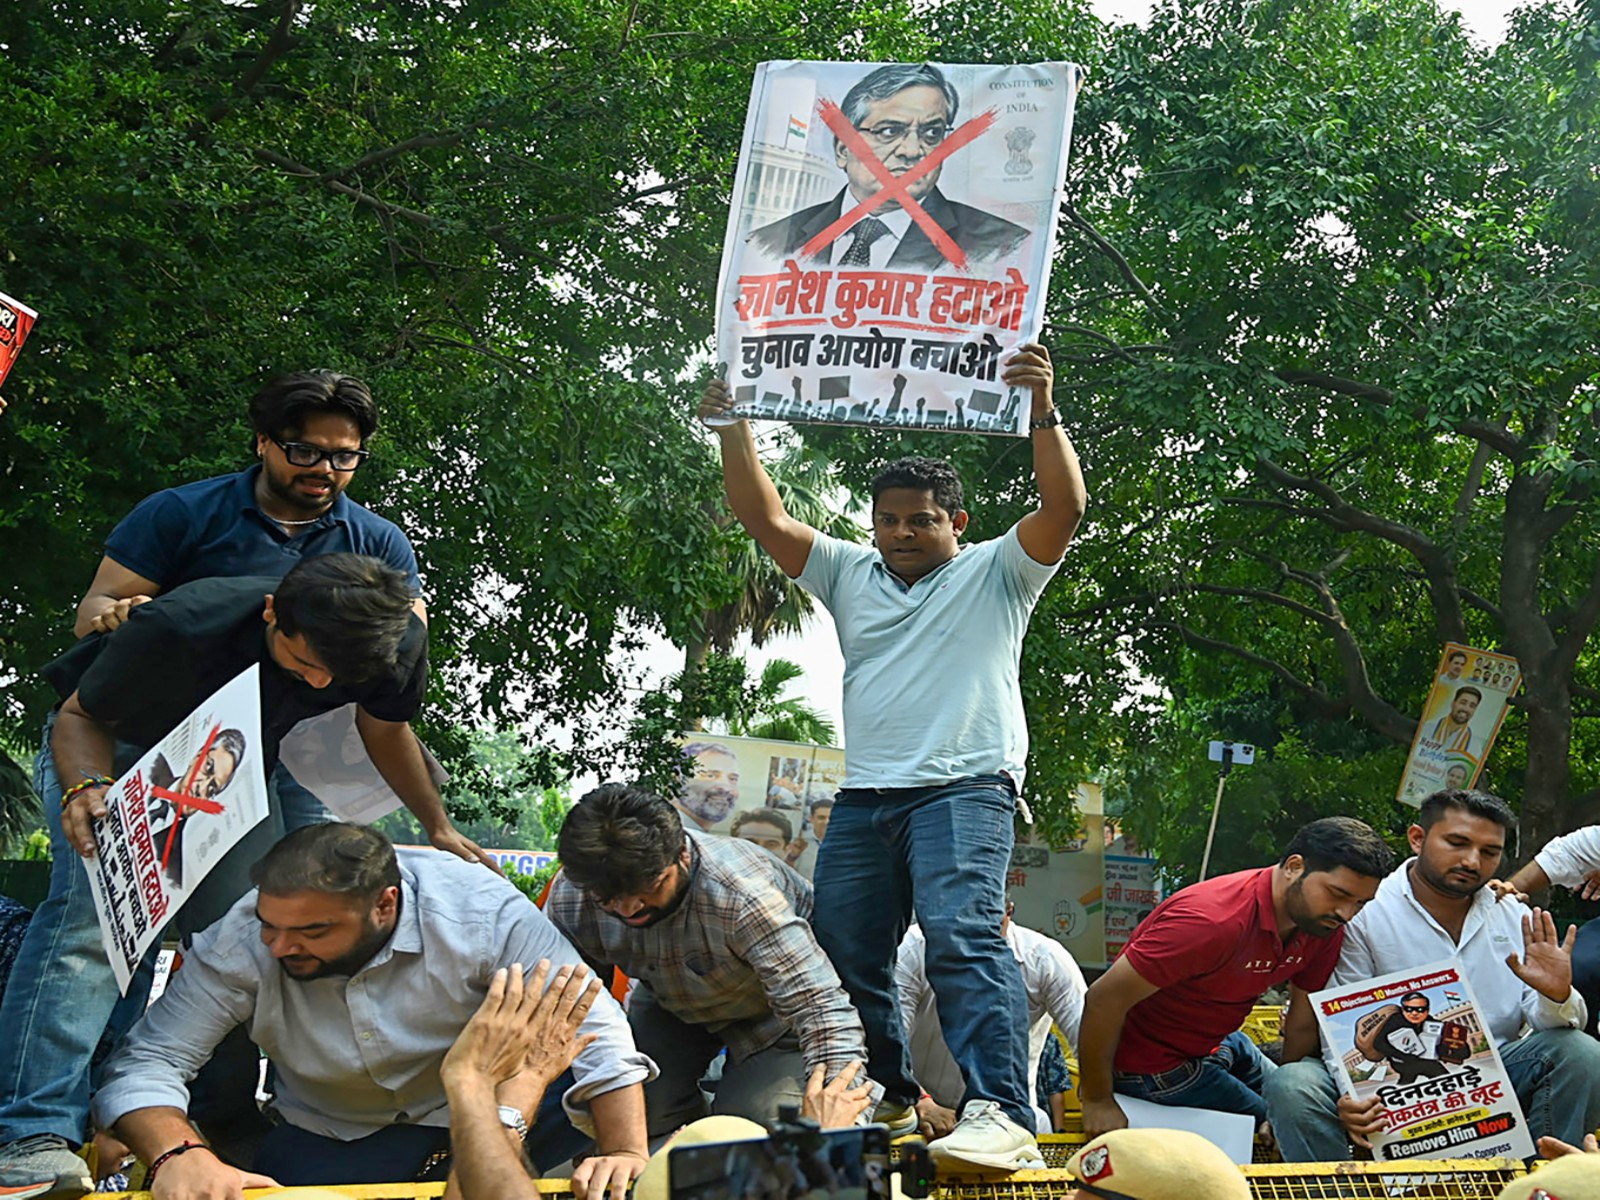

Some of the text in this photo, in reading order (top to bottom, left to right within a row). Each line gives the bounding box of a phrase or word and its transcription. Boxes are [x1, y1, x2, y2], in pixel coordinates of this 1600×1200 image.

[989, 78, 1054, 90] CONSTITUTION
[1006, 103, 1038, 113] INDIA
[736, 260, 1030, 331] ज्ञानेश कुमार हटाओ
[741, 327, 1004, 382] चुनाव आयोग बचाओ
[116, 838, 134, 888] आयोग
[129, 883, 148, 940] बचाओ
[128, 816, 156, 874] कुमार
[142, 864, 170, 929] हटाओ
[1327, 1000, 1341, 1013] 14
[1373, 989, 1386, 1001] 10
[1409, 981, 1422, 990] No
[1376, 1065, 1482, 1107] दिनदहाड़े
[1442, 1091, 1467, 1109] की
[1468, 1081, 1505, 1106] लूट
[1389, 1117, 1509, 1158] Remove Him Now
